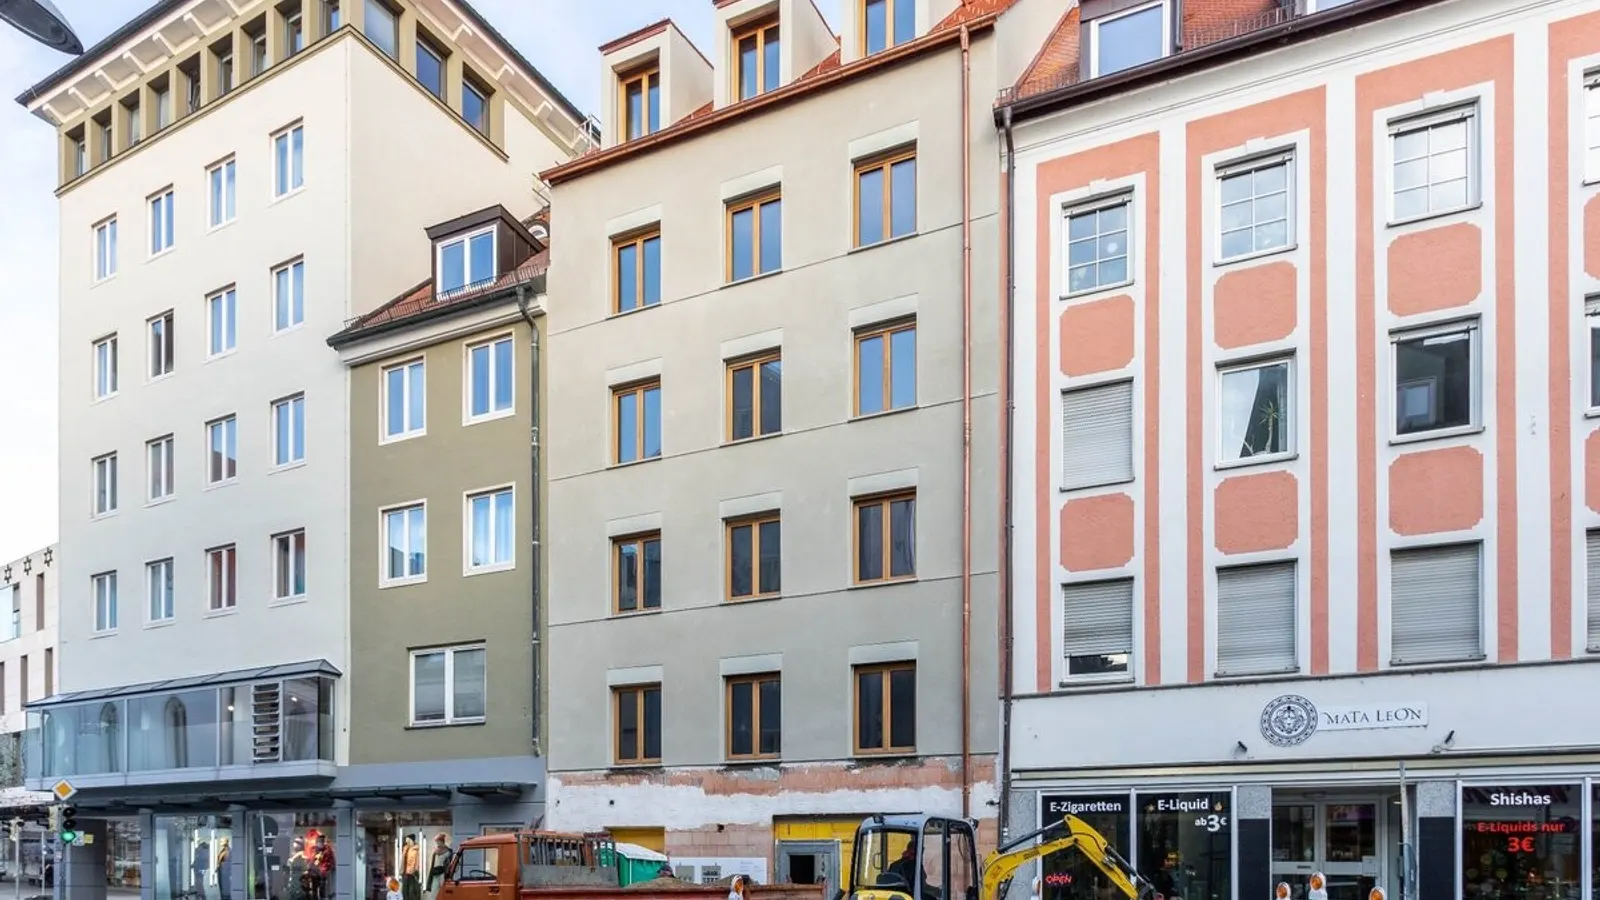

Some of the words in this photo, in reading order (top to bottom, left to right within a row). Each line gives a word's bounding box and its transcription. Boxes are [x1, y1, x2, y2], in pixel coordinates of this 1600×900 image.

[1322, 710, 1369, 724] MATA
[1490, 792, 1551, 805] Shishas
[1050, 801, 1121, 813] E-Zigaretten
[1158, 799, 1208, 812] E-Liquid
[1477, 822, 1537, 834] E-Liquids
[1541, 823, 1566, 832] nur
[1507, 837, 1535, 852] 3€
